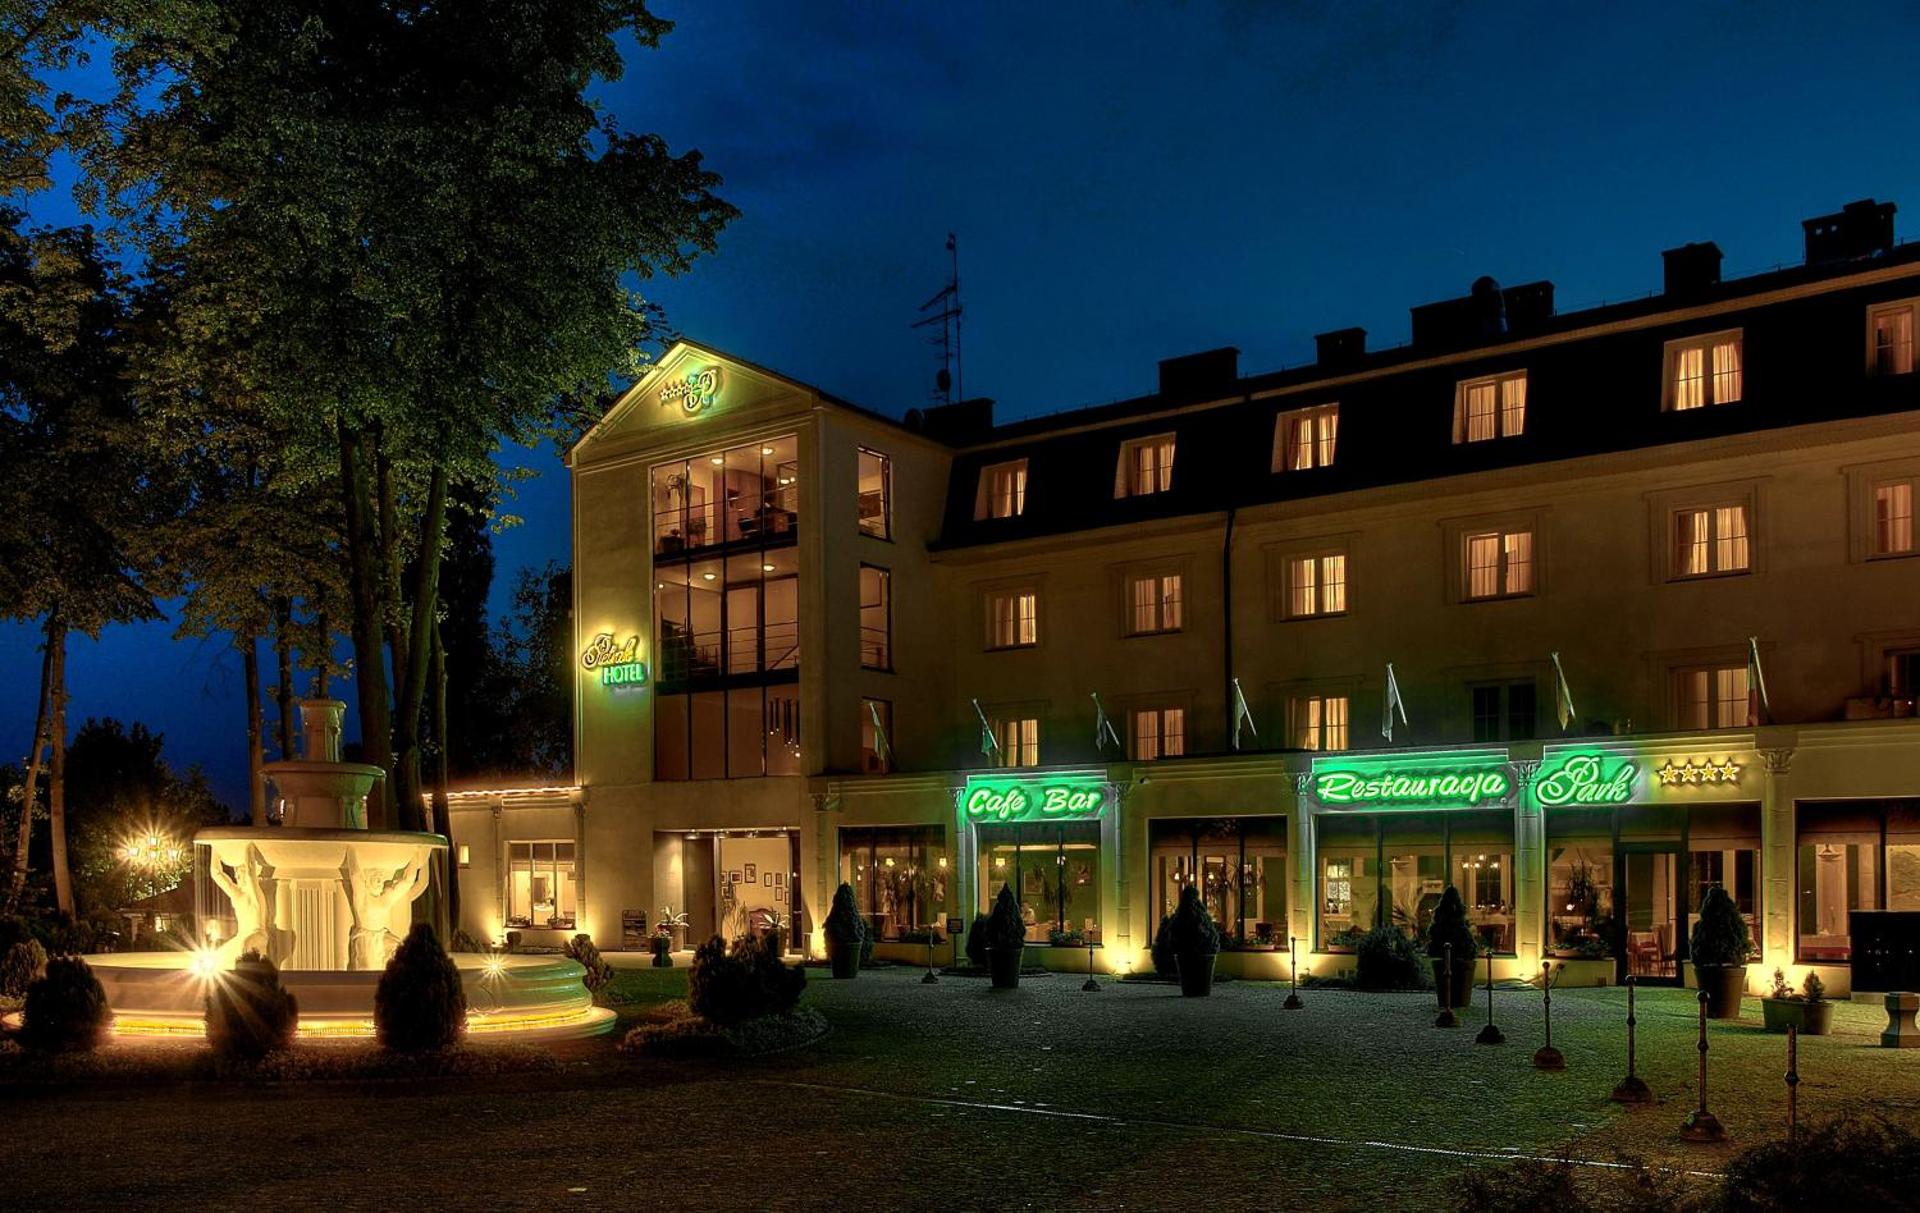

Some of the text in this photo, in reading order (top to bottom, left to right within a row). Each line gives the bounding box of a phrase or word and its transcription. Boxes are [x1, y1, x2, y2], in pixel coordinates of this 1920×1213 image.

[603, 663, 645, 684] HOTEL
[1317, 773, 1505, 802] Restauracja
[1537, 757, 1634, 804] Park
[1043, 788, 1102, 814] Bar
